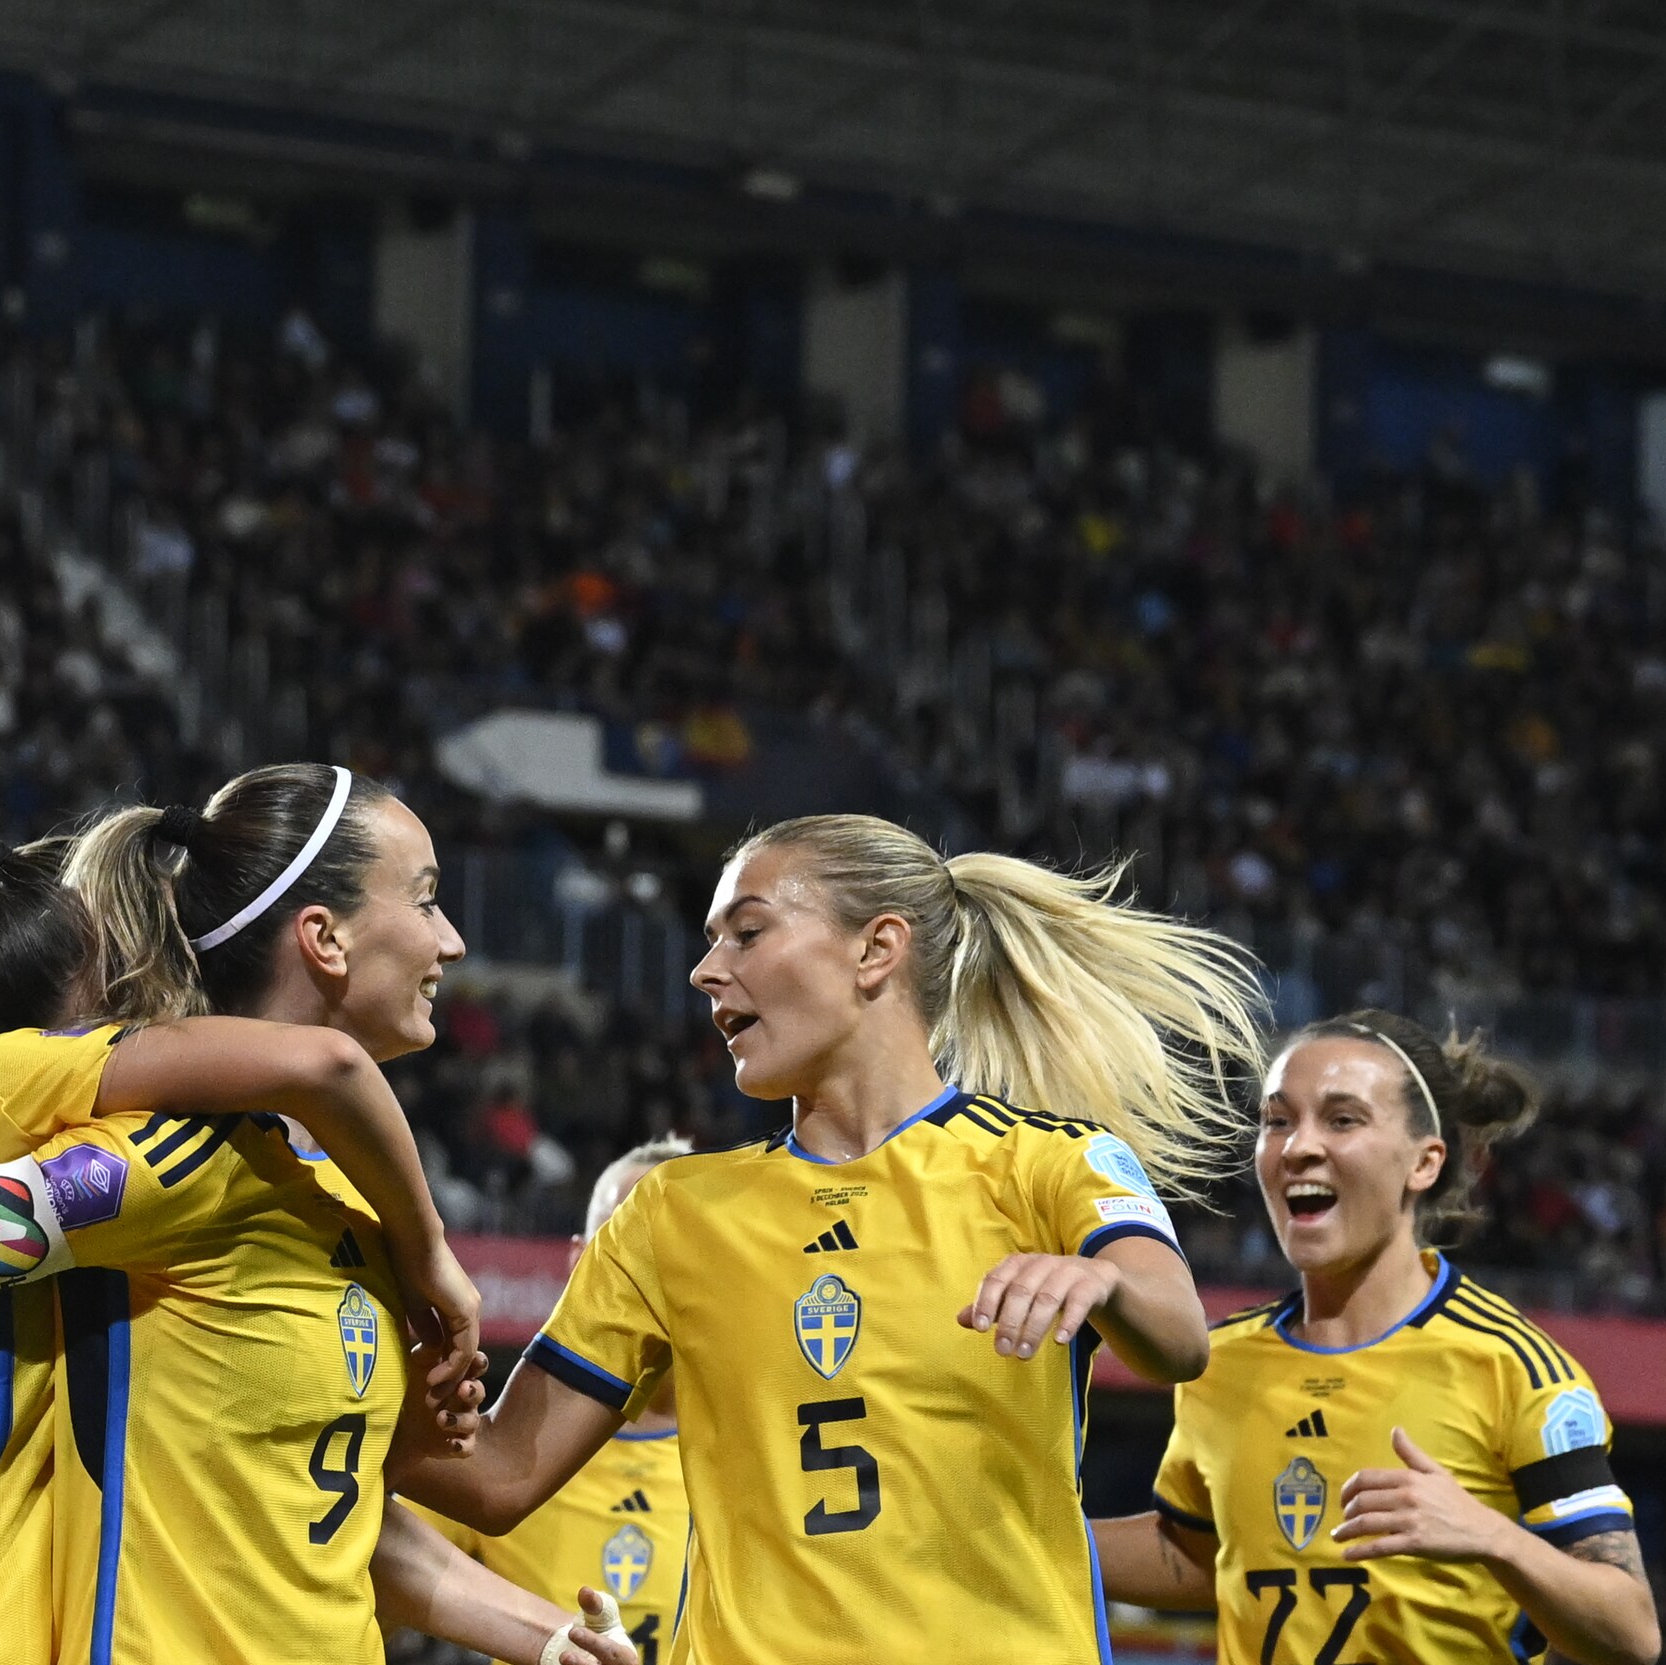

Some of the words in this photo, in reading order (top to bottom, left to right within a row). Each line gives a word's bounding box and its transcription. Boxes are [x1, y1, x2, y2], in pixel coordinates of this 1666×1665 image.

[808, 1304, 849, 1315] SVERIGE
[309, 1414, 367, 1545] 9
[797, 1397, 882, 1536] 5
